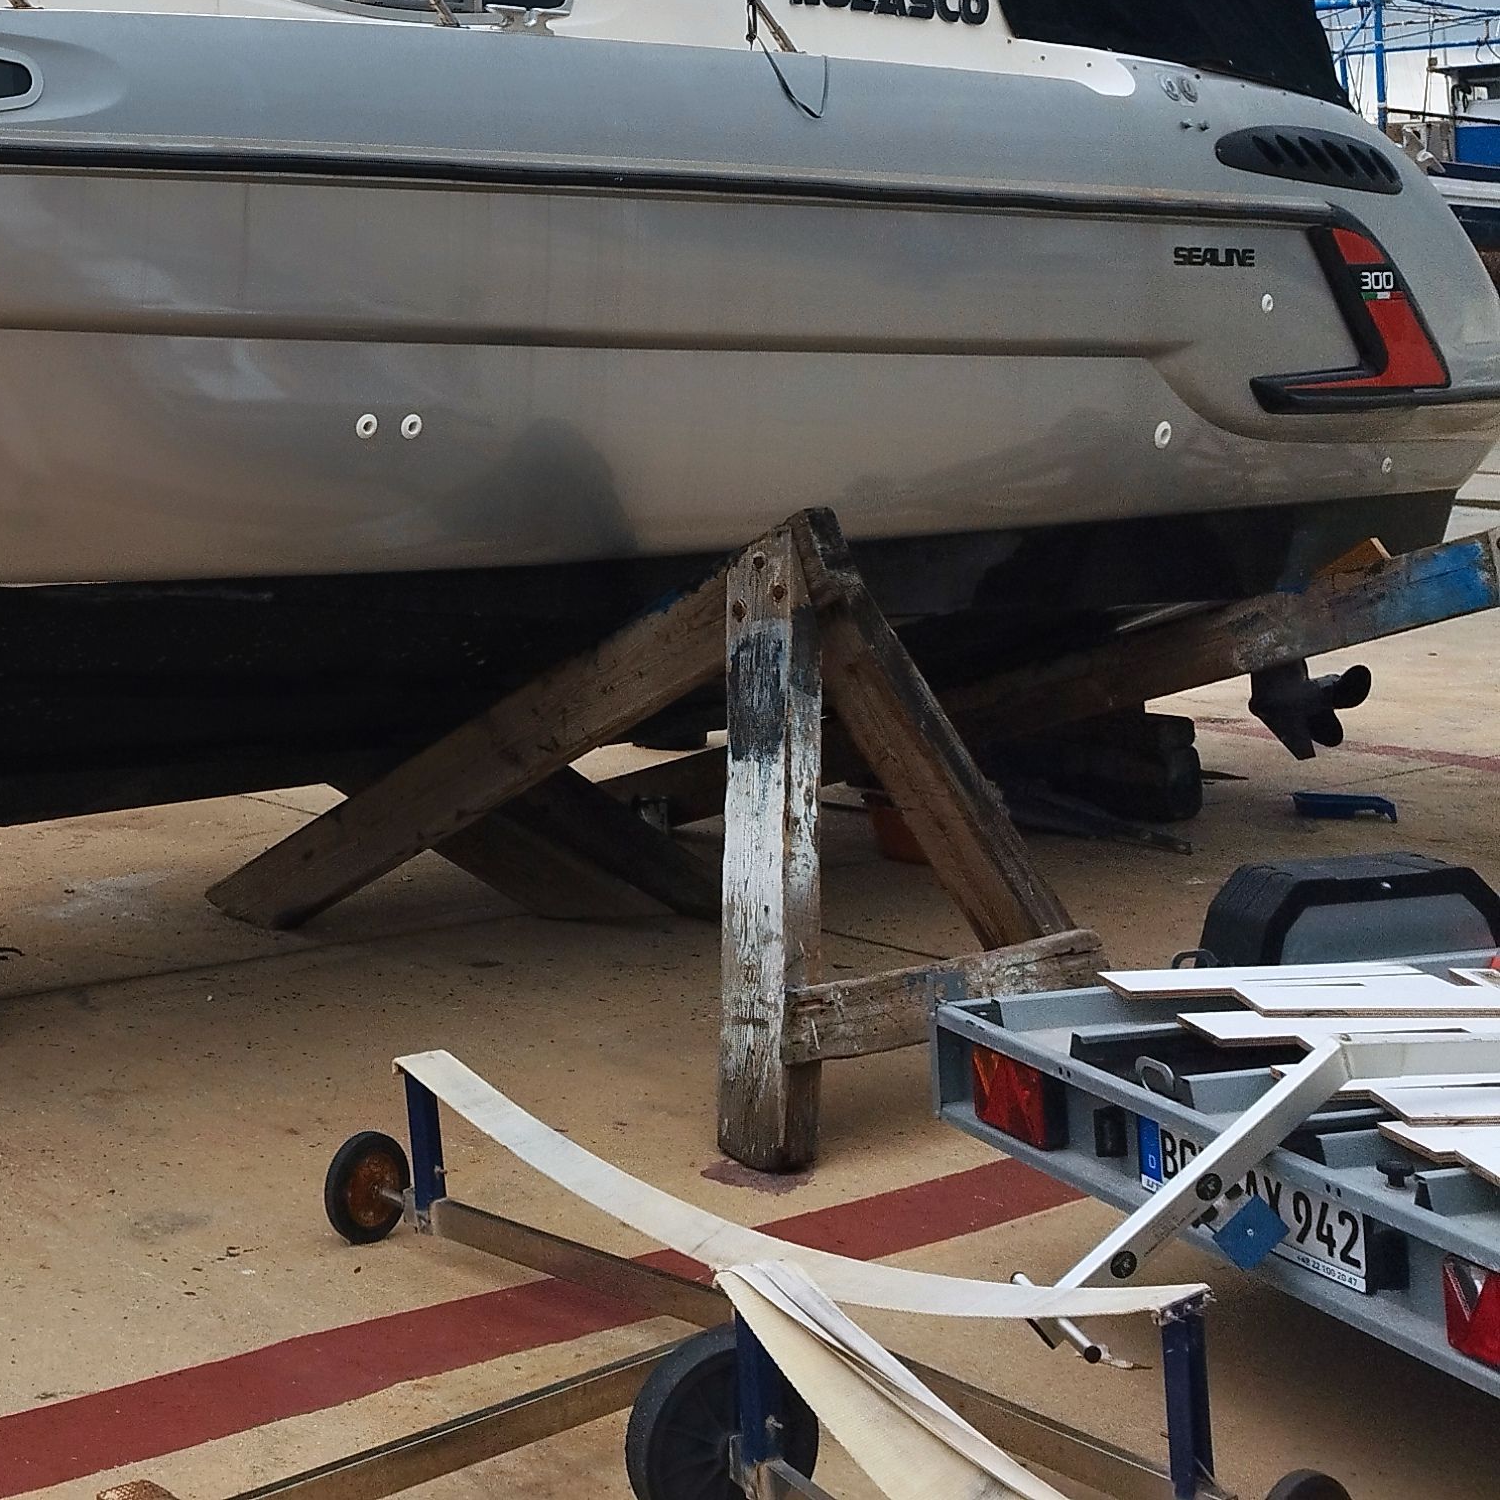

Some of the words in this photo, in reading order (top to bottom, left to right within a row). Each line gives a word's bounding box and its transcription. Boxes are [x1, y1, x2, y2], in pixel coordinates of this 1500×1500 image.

[1173, 247, 1255, 267] SEALINE
[1360, 271, 1394, 290] 300
[1292, 1190, 1362, 1270] 942
